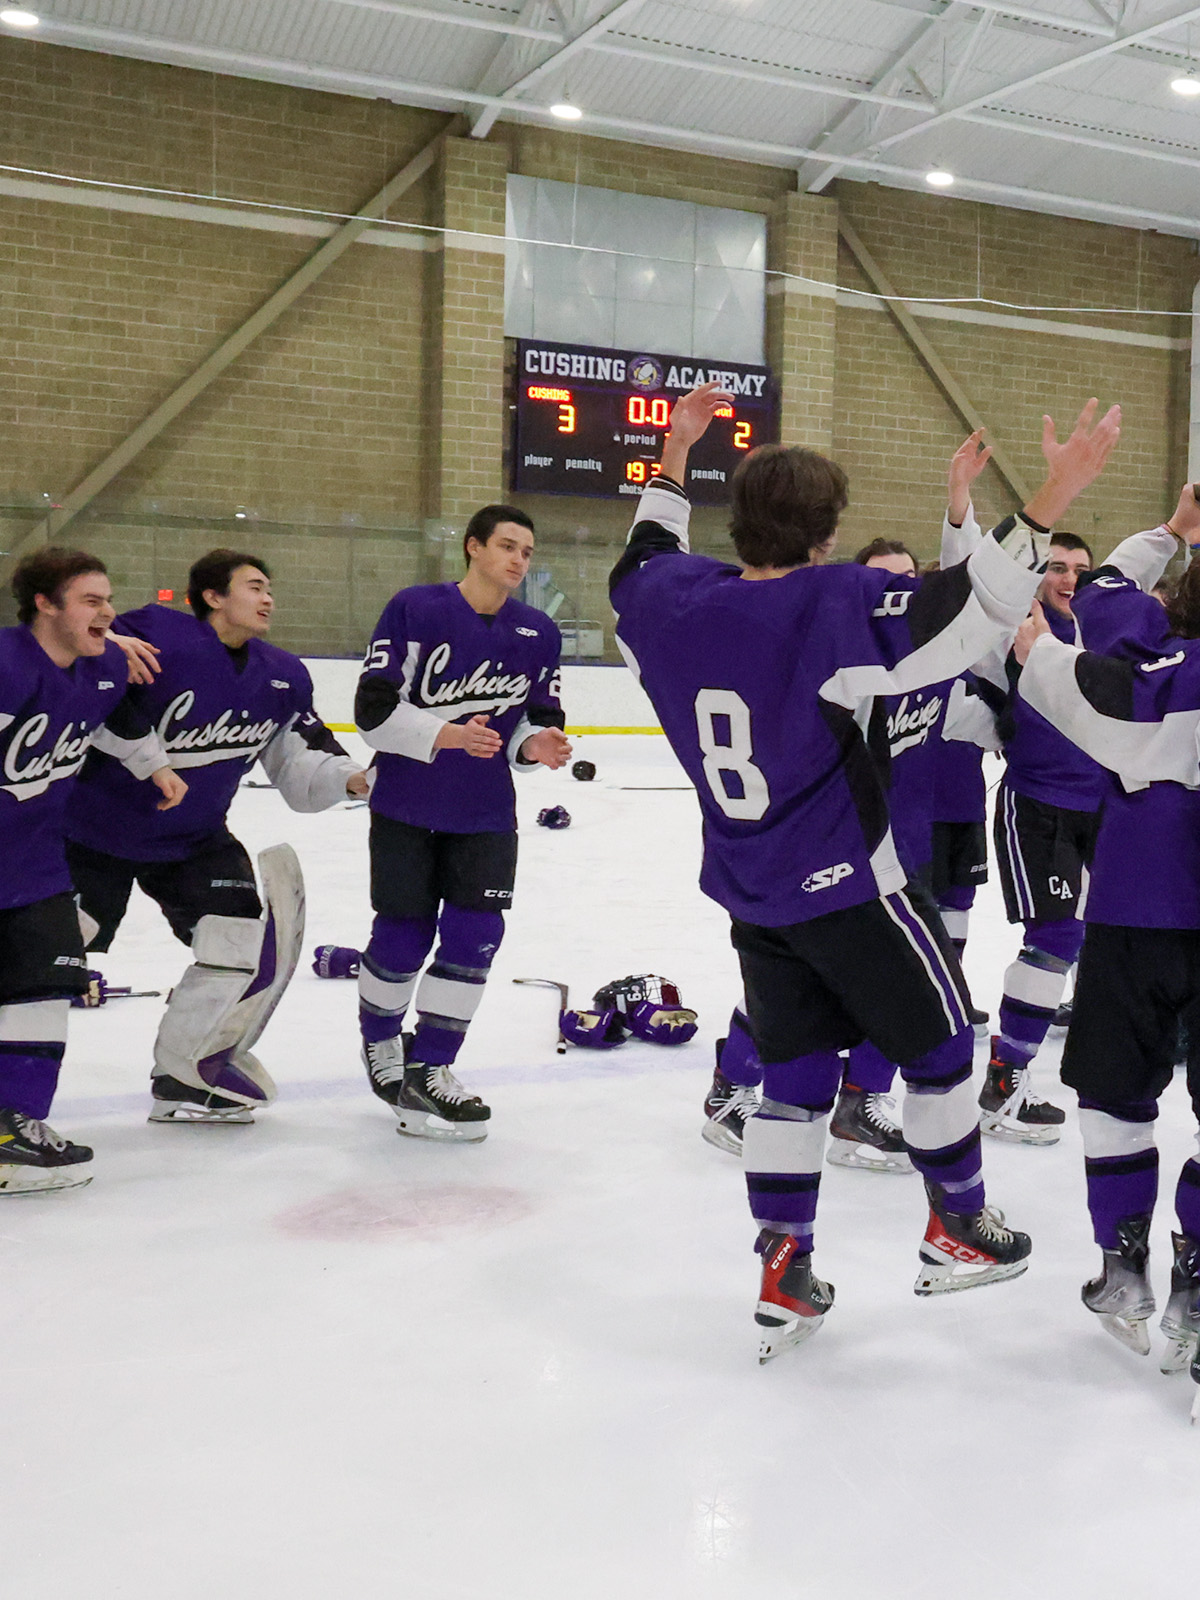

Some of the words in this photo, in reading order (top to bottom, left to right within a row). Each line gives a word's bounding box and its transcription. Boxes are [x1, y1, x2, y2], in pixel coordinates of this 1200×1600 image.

[525, 349, 626, 382] CUSHING
[665, 365, 767, 397] ACADEMY
[527, 385, 571, 402] CUSHING
[557, 404, 576, 433] 3
[624, 433, 656, 446] period
[733, 421, 751, 449] 2
[524, 453, 553, 467] player
[565, 458, 602, 472] penalty
[691, 468, 726, 482] penalty
[420, 643, 531, 716] Cushing
[156, 690, 279, 763] Cushing
[694, 688, 771, 821] 8
[1048, 875, 1074, 899] CA
[770, 1242, 792, 1270] CCM
